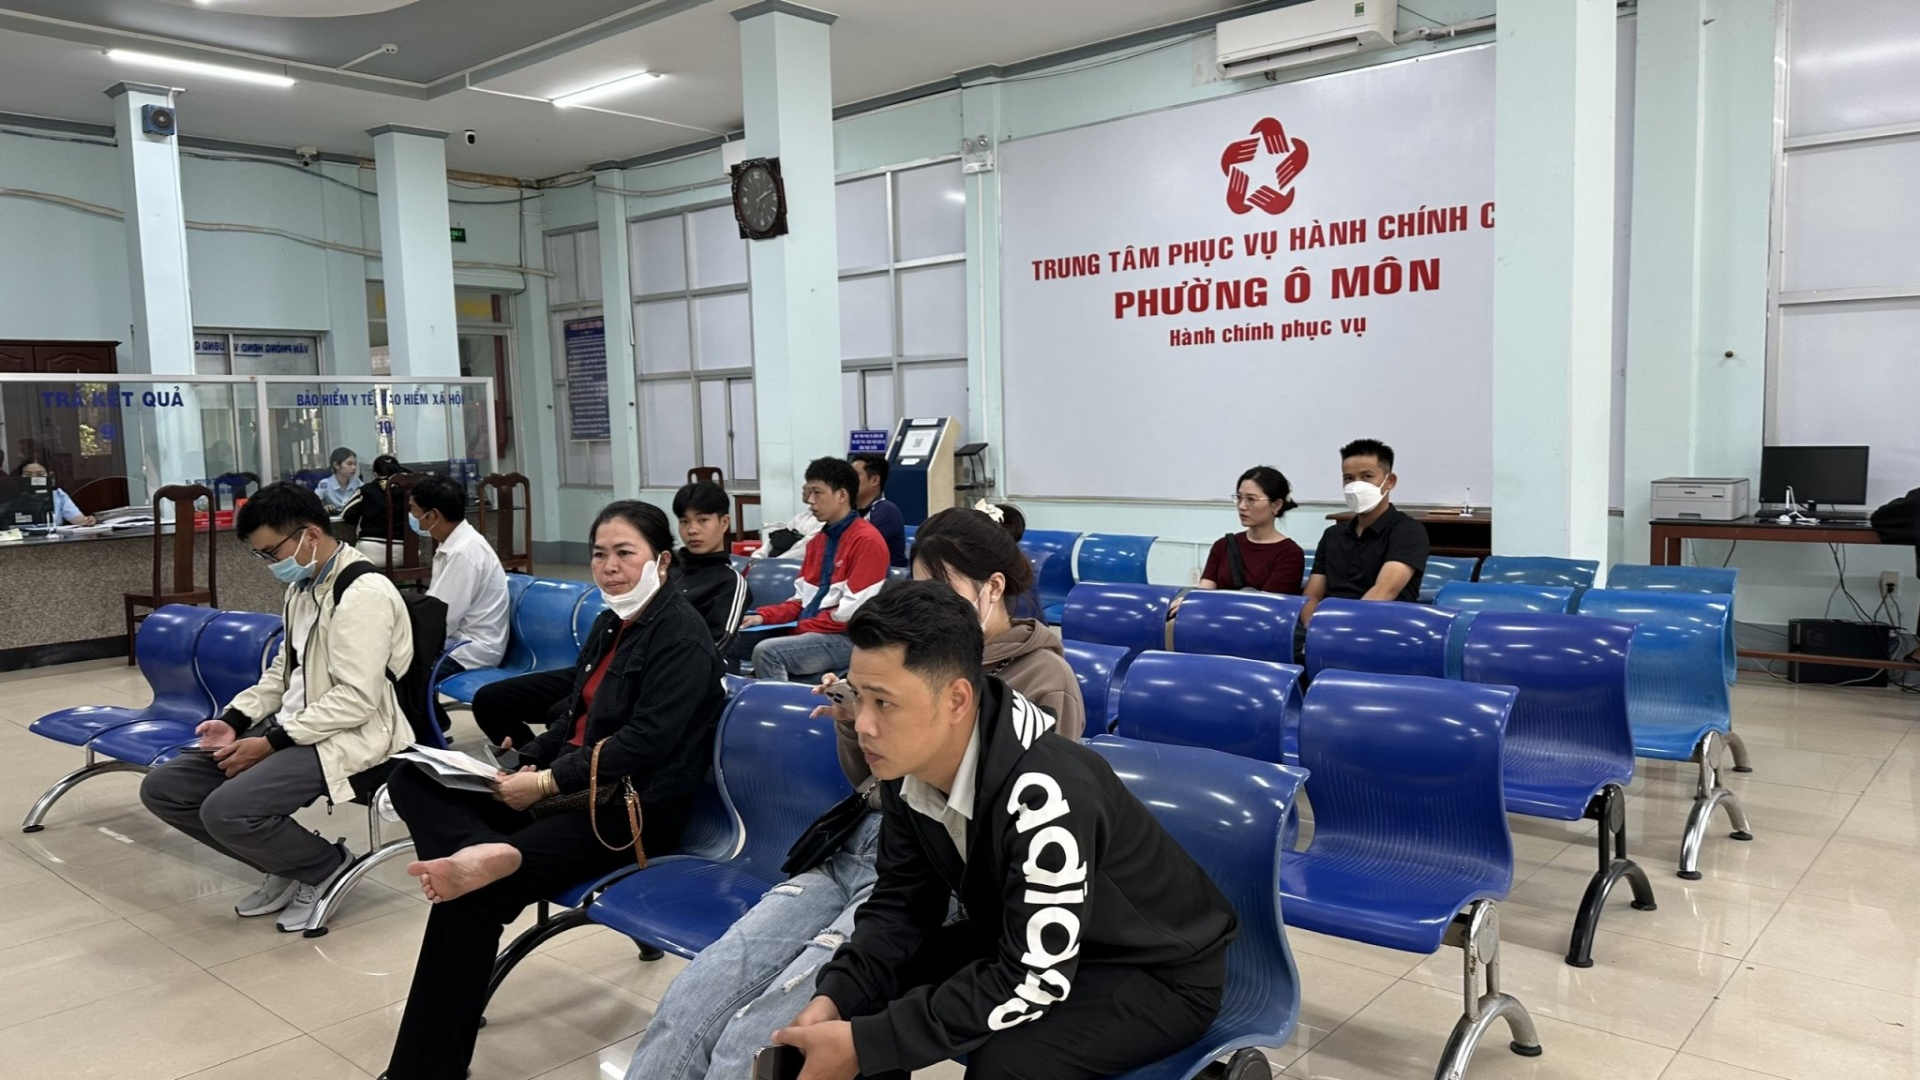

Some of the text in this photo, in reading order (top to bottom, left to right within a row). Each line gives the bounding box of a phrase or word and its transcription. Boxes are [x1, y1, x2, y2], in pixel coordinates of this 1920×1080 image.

[1031, 253, 1100, 281] TRUNG
[1108, 245, 1160, 273] TÂM
[1168, 236, 1234, 267] PHỤC
[1244, 230, 1278, 260] VỤ
[1289, 218, 1367, 251] HÀNH
[1378, 205, 1468, 240] CHÍNH
[1114, 256, 1441, 319] PHƯỜNG Ô MÔN
[1169, 317, 1367, 347] Hành chính phục vụ
[41, 384, 185, 408] TRẢ KẾT QUẢ
[296, 388, 319, 406] BẢO
[321, 387, 349, 406] HIỂM
[352, 394, 358, 406] Y
[404, 386, 429, 406] HIỂM
[432, 391, 446, 406] XÃ
[448, 390, 465, 408] HỘI
[378, 420, 392, 435] 10
[987, 772, 1088, 1031] adidas
